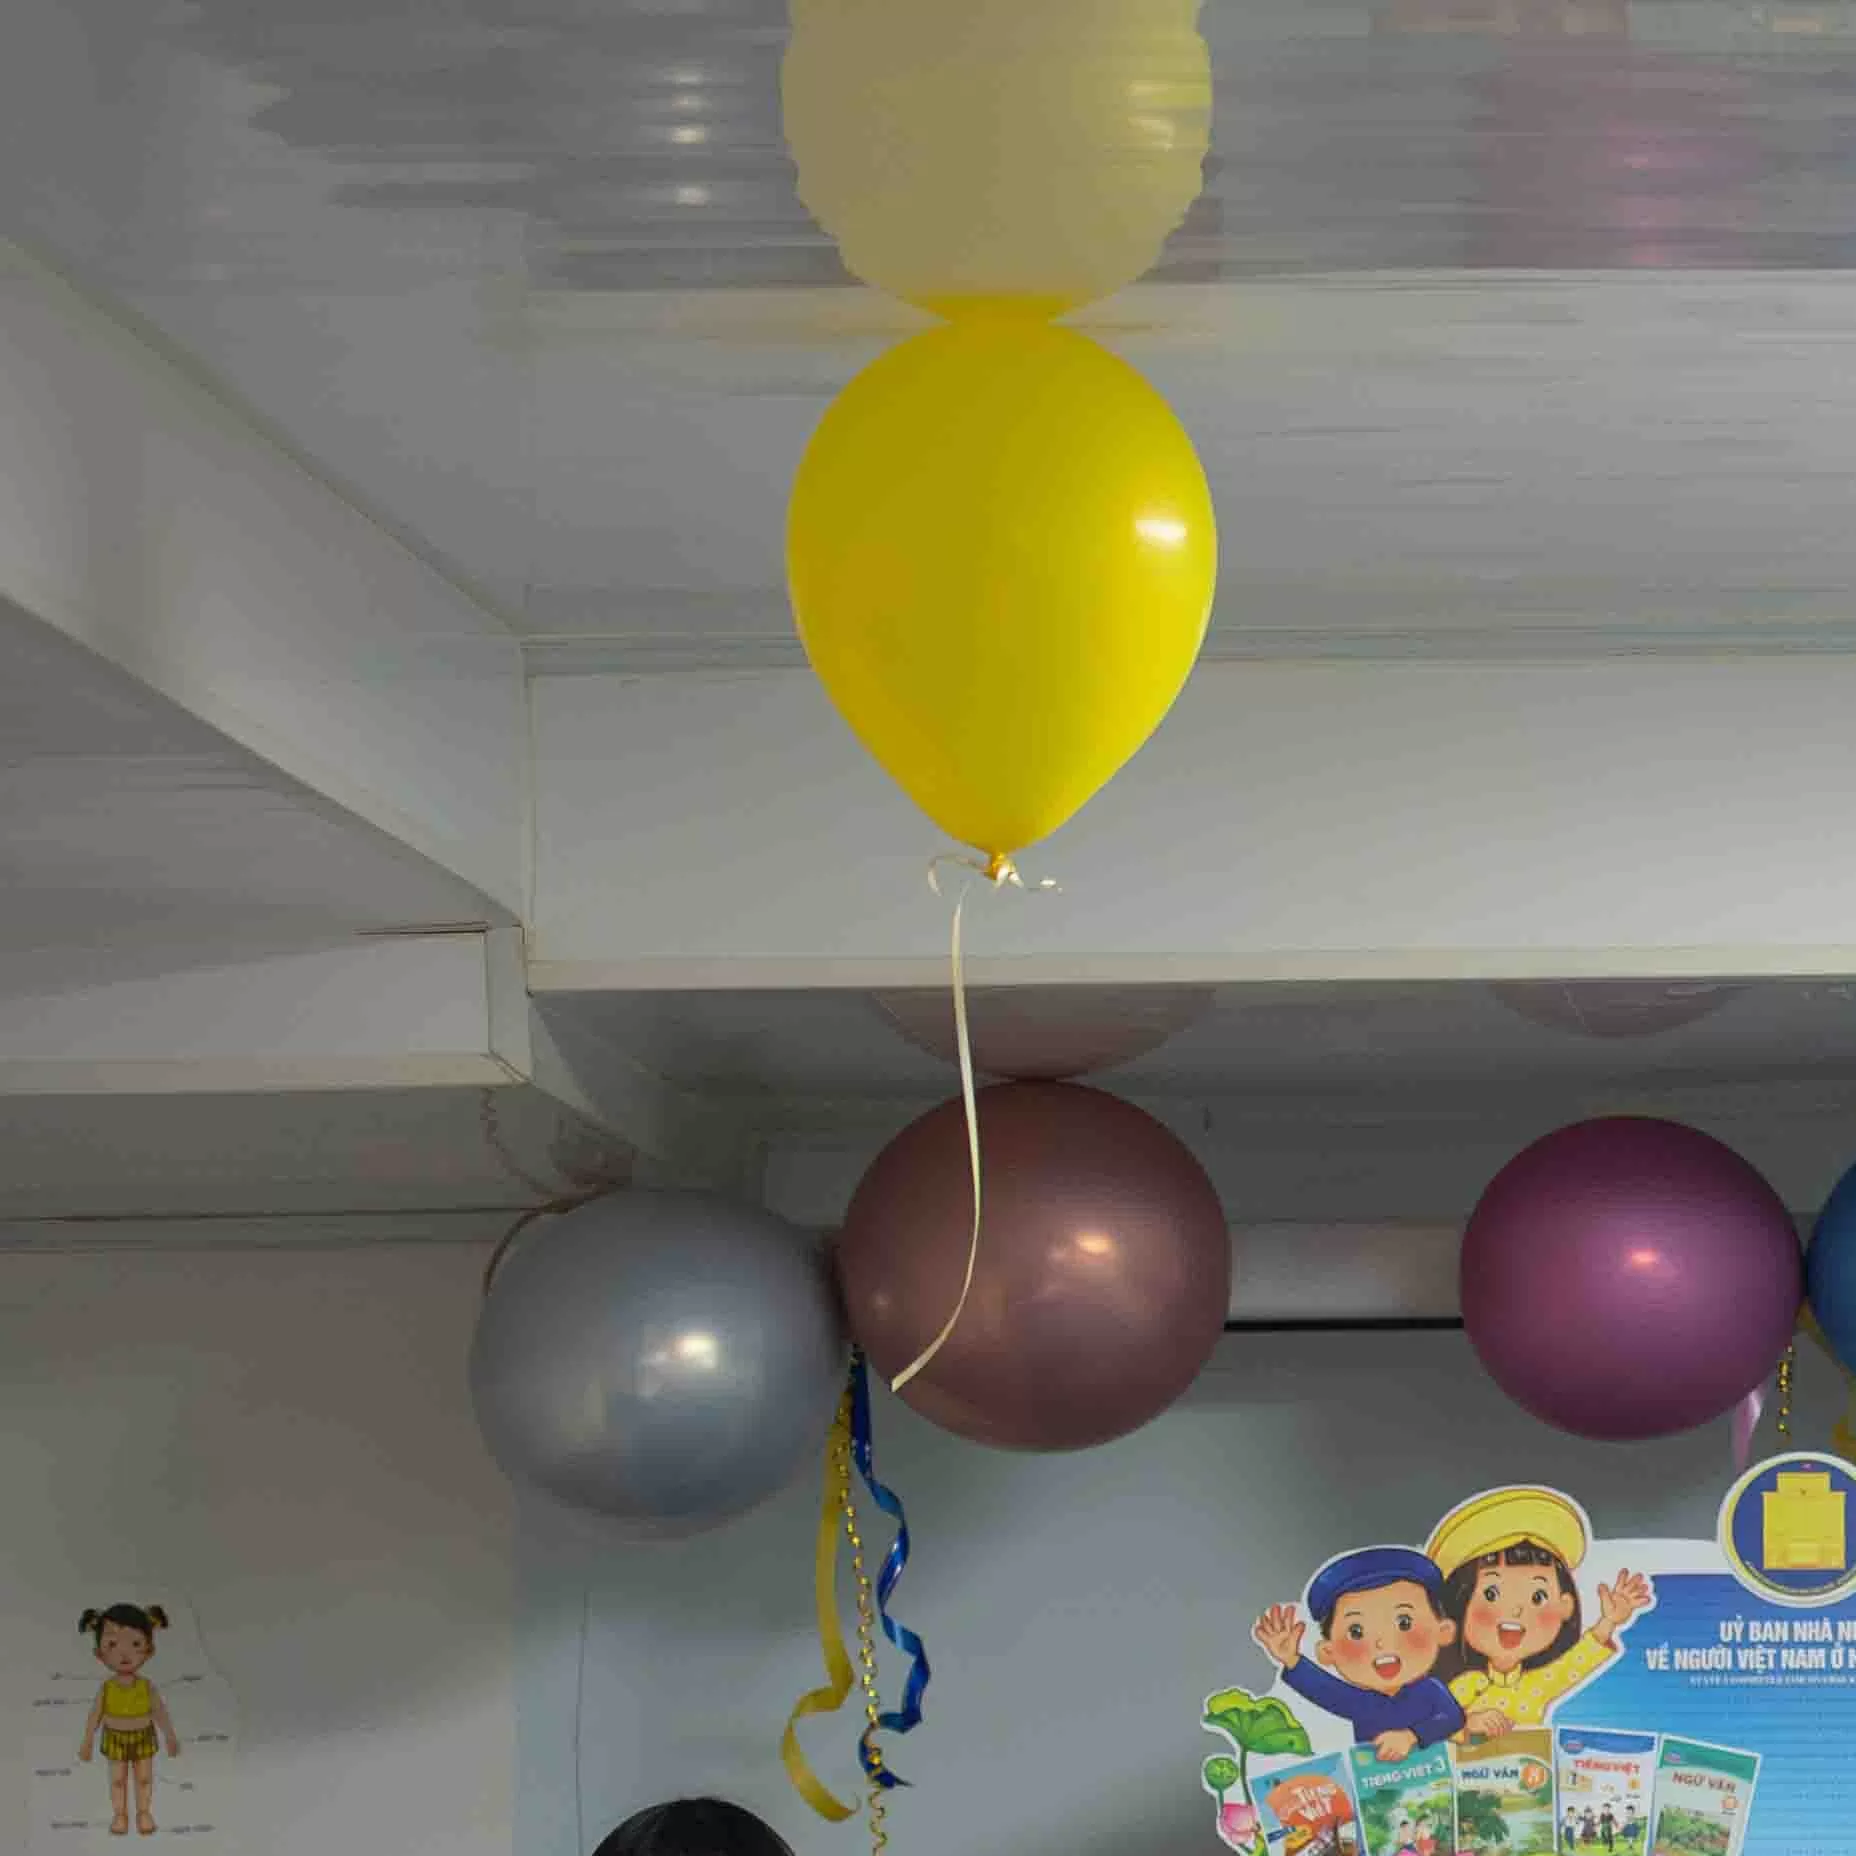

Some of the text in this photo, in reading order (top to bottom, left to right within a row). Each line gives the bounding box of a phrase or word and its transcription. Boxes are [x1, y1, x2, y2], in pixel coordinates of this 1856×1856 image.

[1750, 1621, 1790, 1642] BAN
[1794, 1617, 1833, 1642] NHÀ
[1737, 1644, 1775, 1674] VIỆT
[1781, 1648, 1825, 1670] NAM
